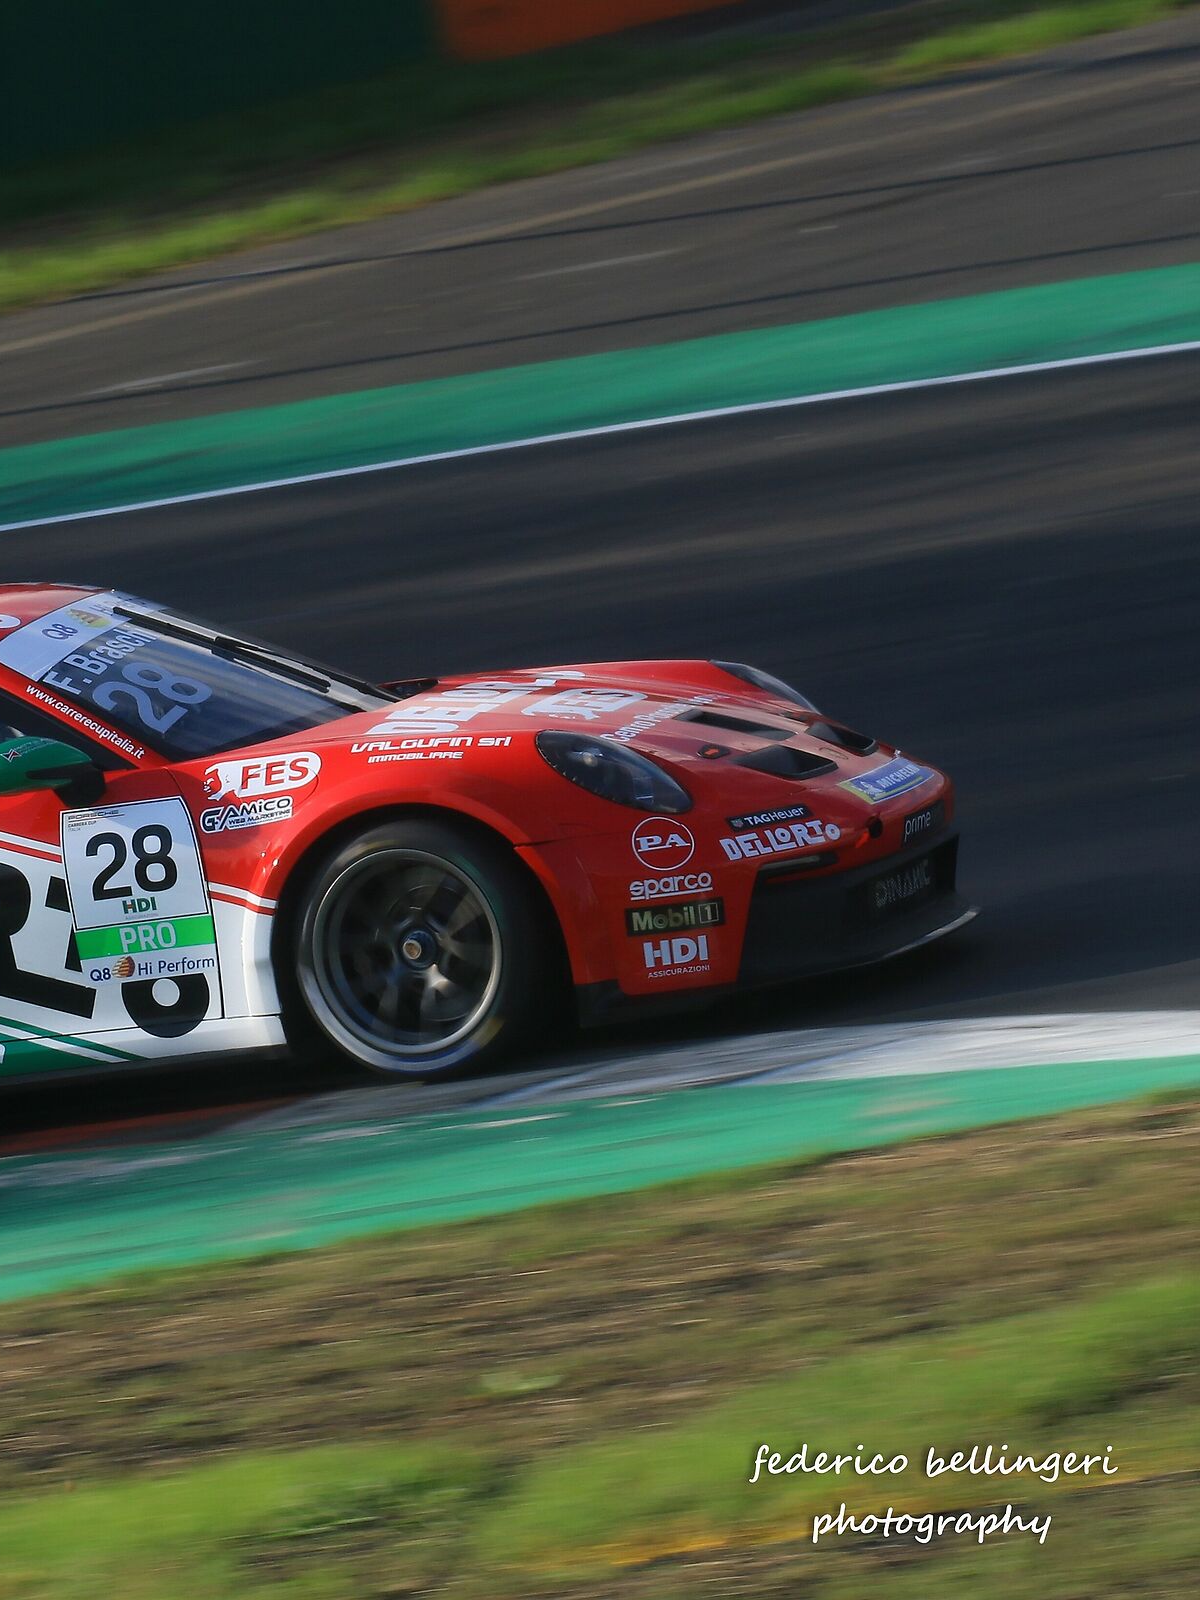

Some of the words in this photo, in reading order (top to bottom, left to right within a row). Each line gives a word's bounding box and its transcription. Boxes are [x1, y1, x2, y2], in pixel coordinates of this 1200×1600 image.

[42, 623, 78, 640] Q8
[92, 662, 212, 734] 28
[367, 751, 463, 764] IMMOBILIARE
[241, 756, 310, 790] FES
[876, 764, 921, 789] MICHELIN
[68, 809, 119, 820] PORSCHE
[246, 809, 292, 823] MARKETING
[904, 811, 931, 843] prime
[636, 833, 691, 853] PA
[719, 819, 841, 861] DELLORTO
[85, 824, 178, 901] 28
[629, 872, 713, 900] sparco
[122, 896, 157, 914] HDI
[632, 906, 696, 931] Mobil
[119, 922, 177, 953] PRO
[643, 935, 709, 968] HDI
[90, 968, 112, 982] Q8
[138, 961, 153, 975] Hi
[158, 956, 215, 974] Perform
[647, 964, 711, 979] ASSICURAZIONI
